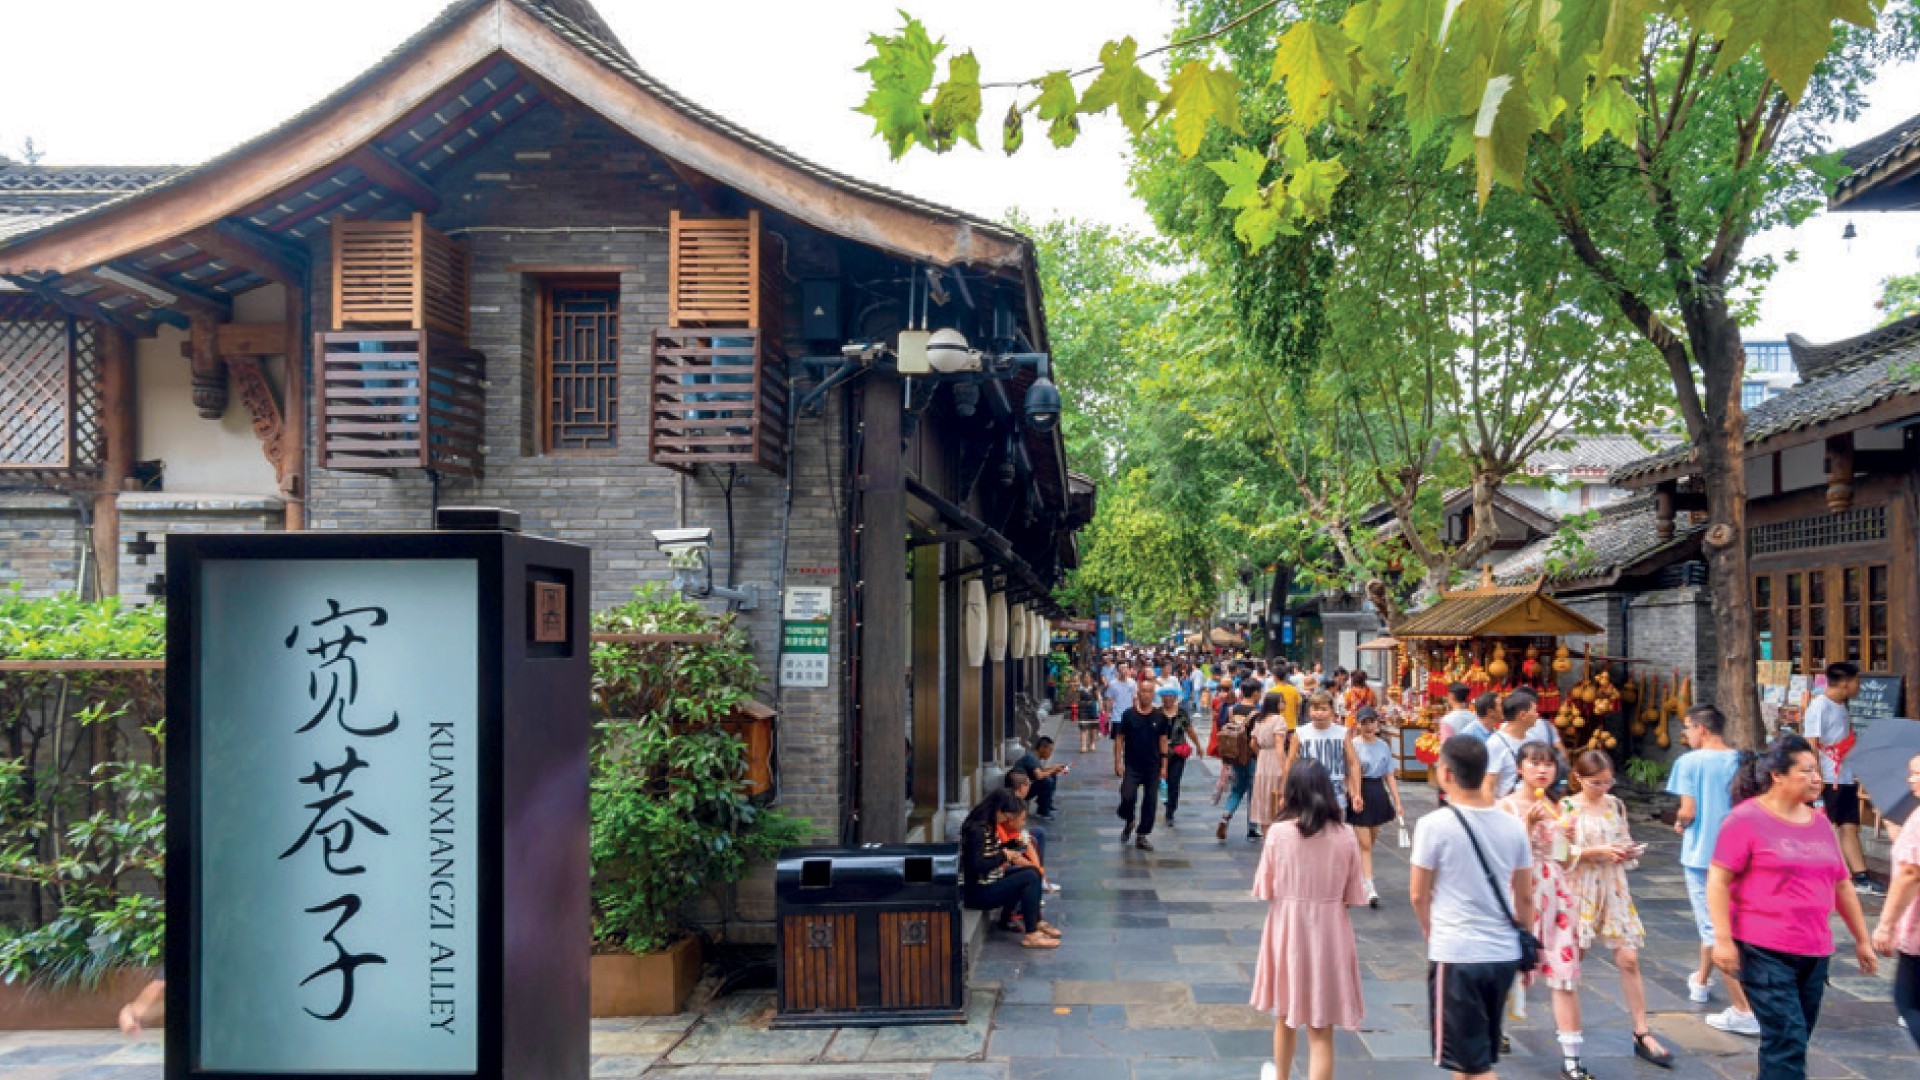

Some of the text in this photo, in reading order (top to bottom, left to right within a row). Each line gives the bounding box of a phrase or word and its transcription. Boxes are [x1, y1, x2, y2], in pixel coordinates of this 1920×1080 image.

[278, 598, 401, 1022] 宽巷子
[428, 721, 455, 1035] KUANXIANGZI ALLEY
